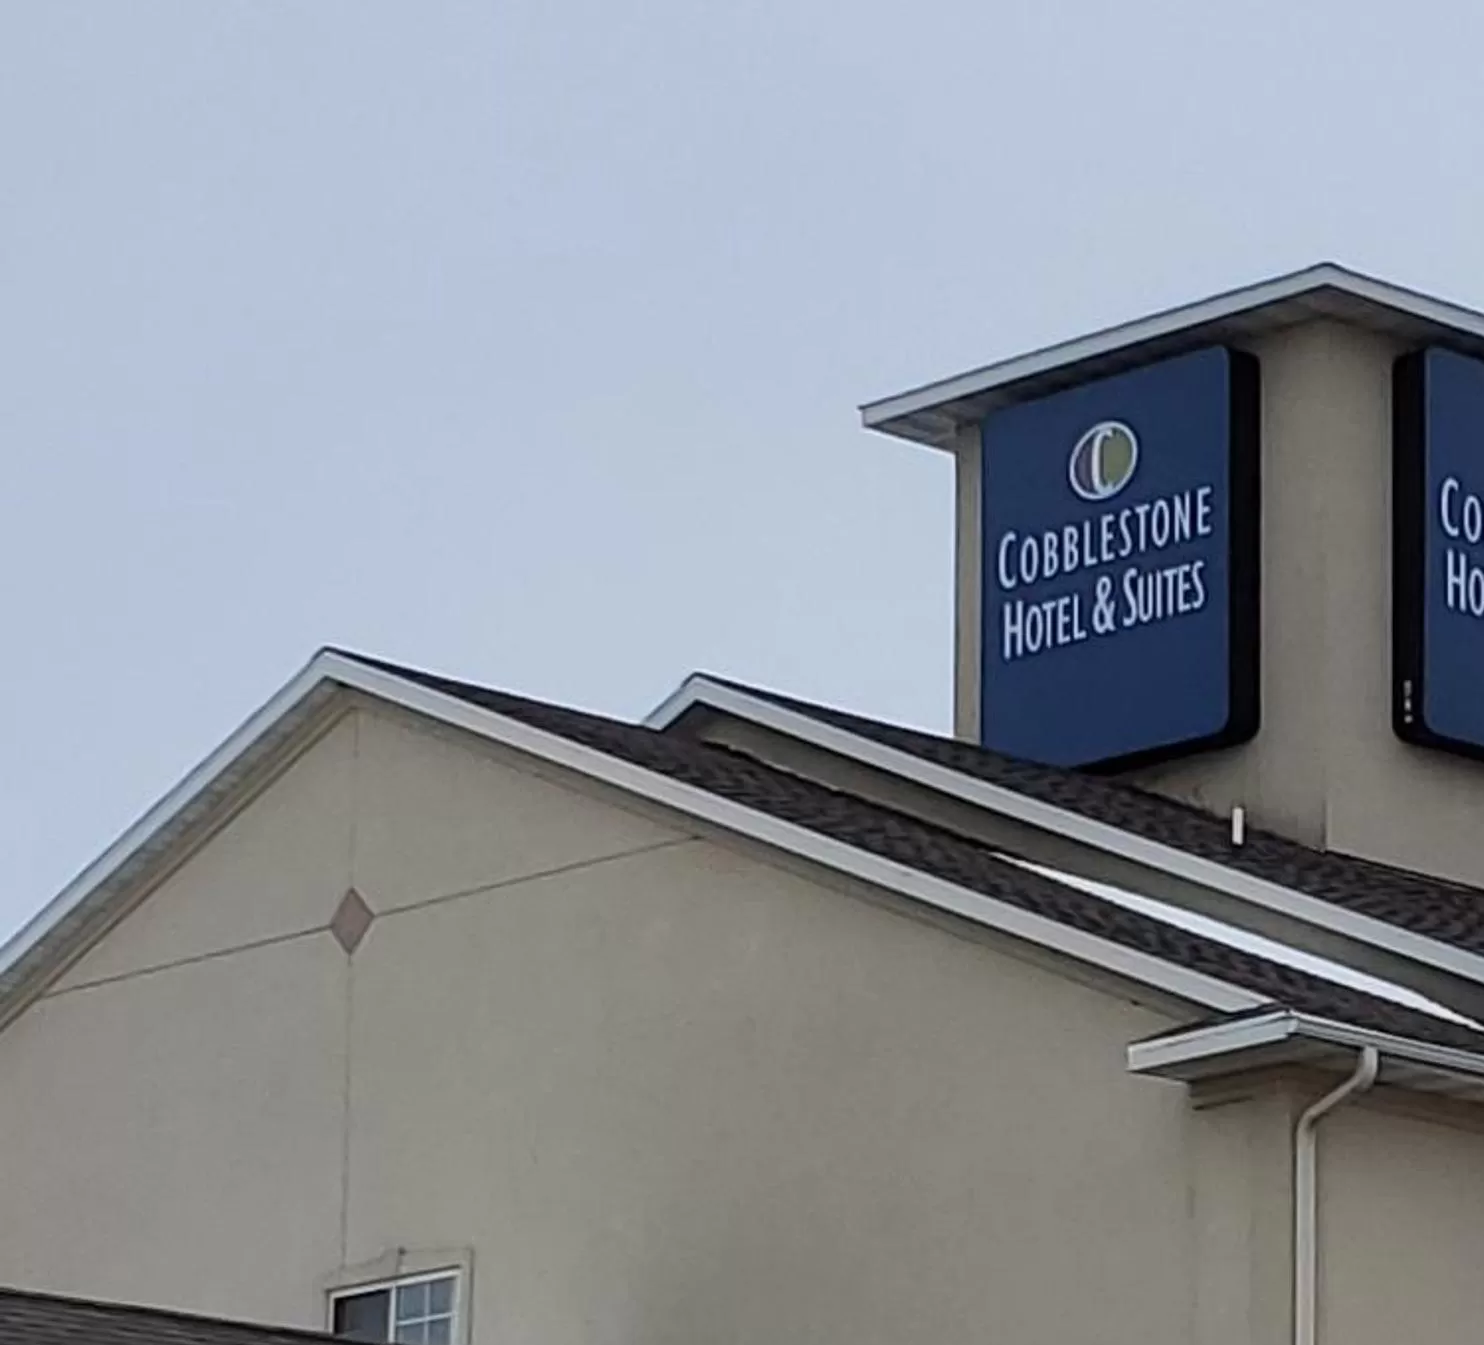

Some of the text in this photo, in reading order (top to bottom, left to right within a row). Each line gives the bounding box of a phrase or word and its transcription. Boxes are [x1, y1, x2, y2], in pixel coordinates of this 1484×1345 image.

[998, 487, 1212, 589] COBBLESTONE
[1004, 560, 1205, 659] HOTEL & SUITES
